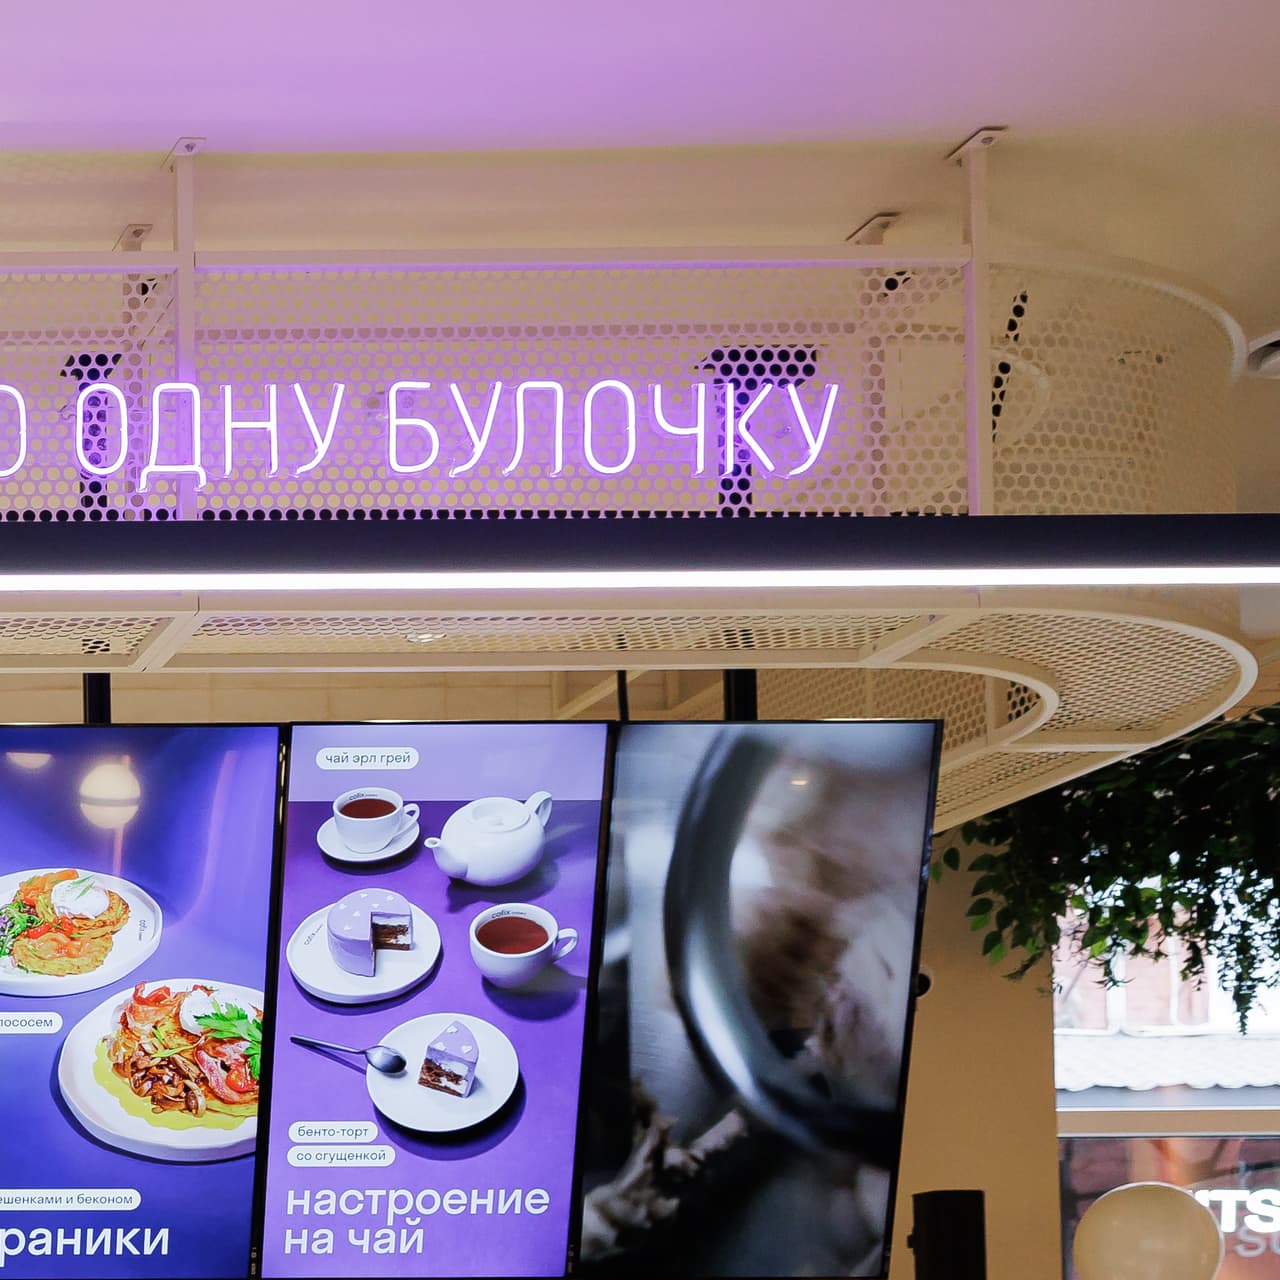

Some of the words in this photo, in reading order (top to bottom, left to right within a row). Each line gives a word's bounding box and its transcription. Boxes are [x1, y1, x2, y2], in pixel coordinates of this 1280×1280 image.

[75, 381, 346, 493] ОДНУ
[386, 380, 840, 479] БУЛОЧКУ
[326, 751, 350, 765] чай
[353, 753, 377, 766] эрл
[379, 751, 411, 767] грей
[492, 909, 511, 918] cofix
[297, 1126, 370, 1140] бенто-торт
[296, 1151, 311, 1161] со
[314, 1149, 387, 1164] сгущенкой
[66, 1196, 74, 1204] и
[77, 1193, 133, 1205] беконом
[287, 1187, 550, 1225] настроение
[1187, 1189, 1280, 1232] TS
[285, 1228, 332, 1254] на
[348, 1217, 424, 1254] чай
